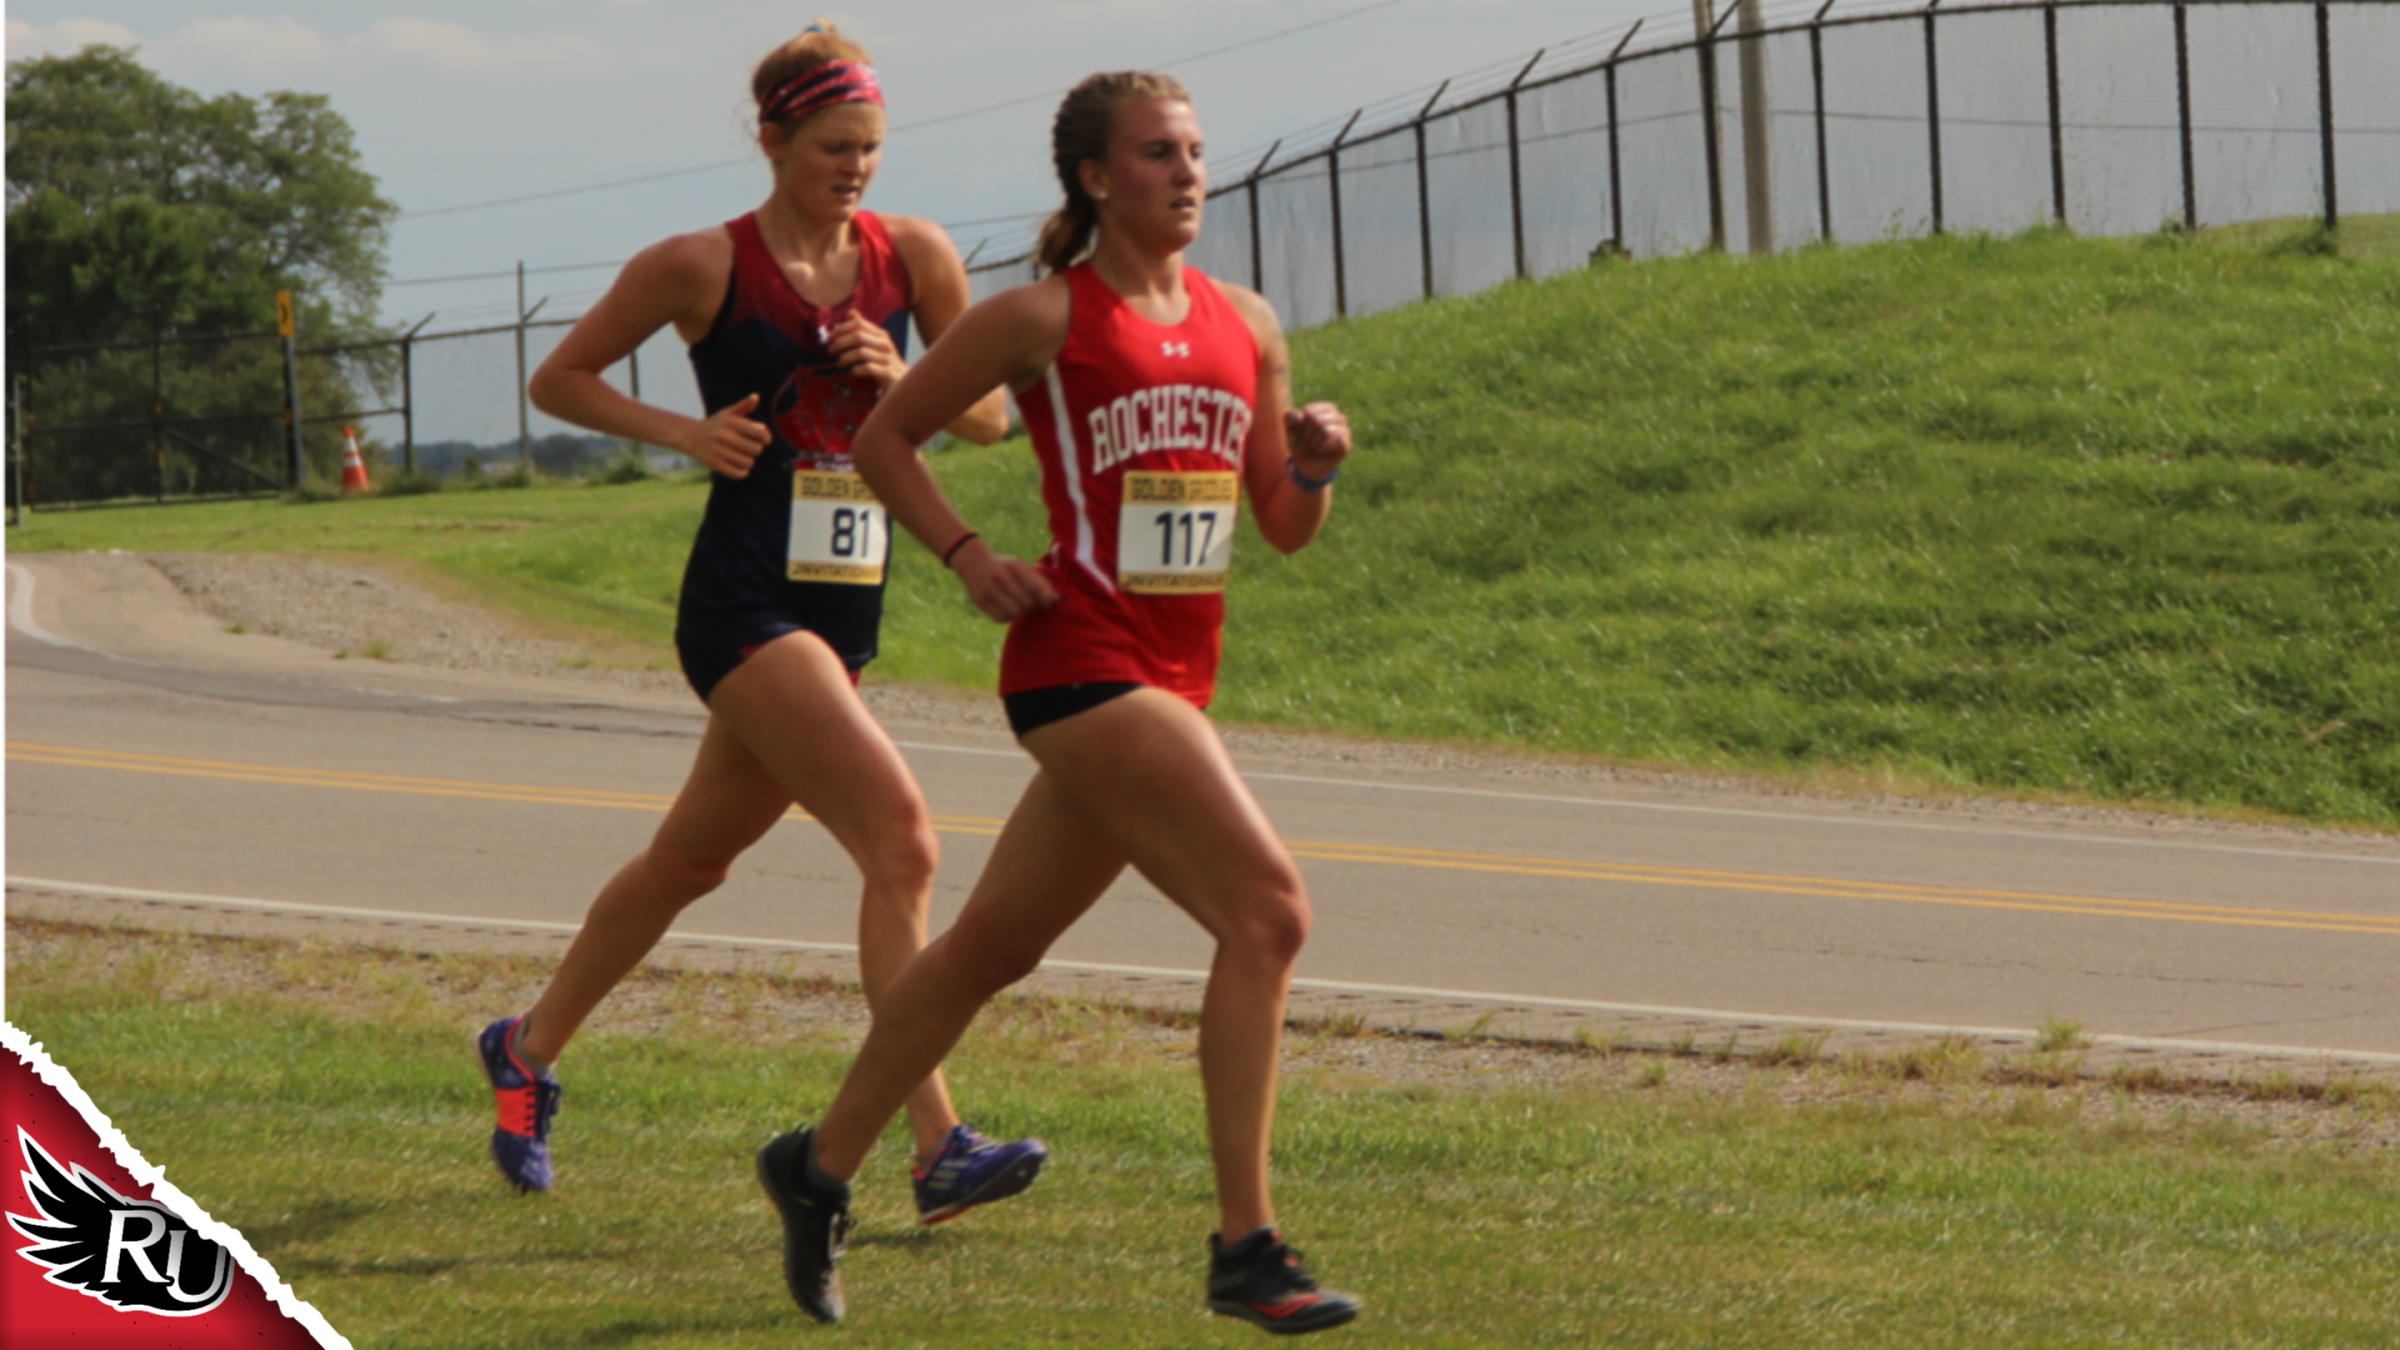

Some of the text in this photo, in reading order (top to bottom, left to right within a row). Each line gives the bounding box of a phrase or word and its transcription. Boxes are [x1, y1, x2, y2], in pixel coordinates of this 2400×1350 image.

[1088, 385, 1252, 474] ROCHESTE
[831, 508, 871, 558] 81
[1155, 511, 1218, 566] 117
